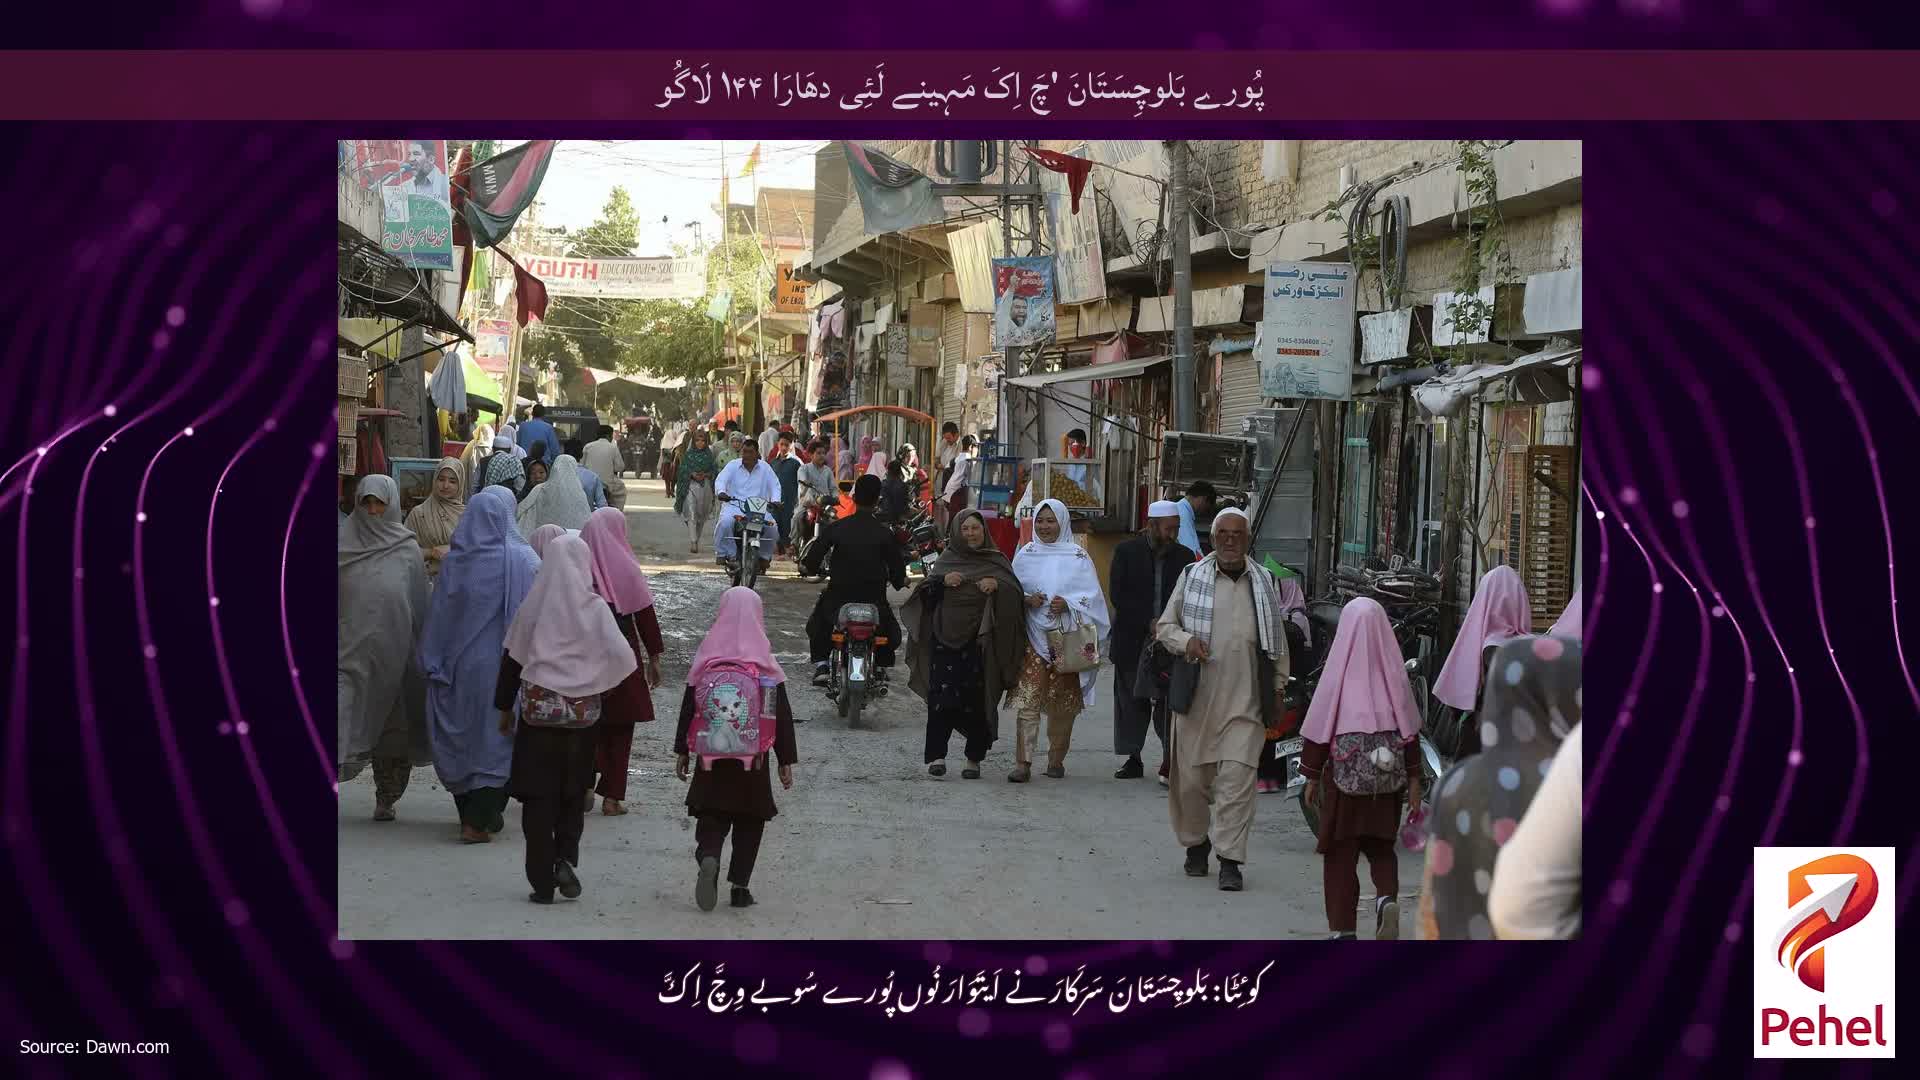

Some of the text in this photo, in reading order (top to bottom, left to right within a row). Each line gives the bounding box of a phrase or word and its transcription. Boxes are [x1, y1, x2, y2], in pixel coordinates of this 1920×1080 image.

[482, 164, 497, 195] MWM
[523, 257, 598, 280] YOUTH
[1270, 265, 1304, 281] رضا
